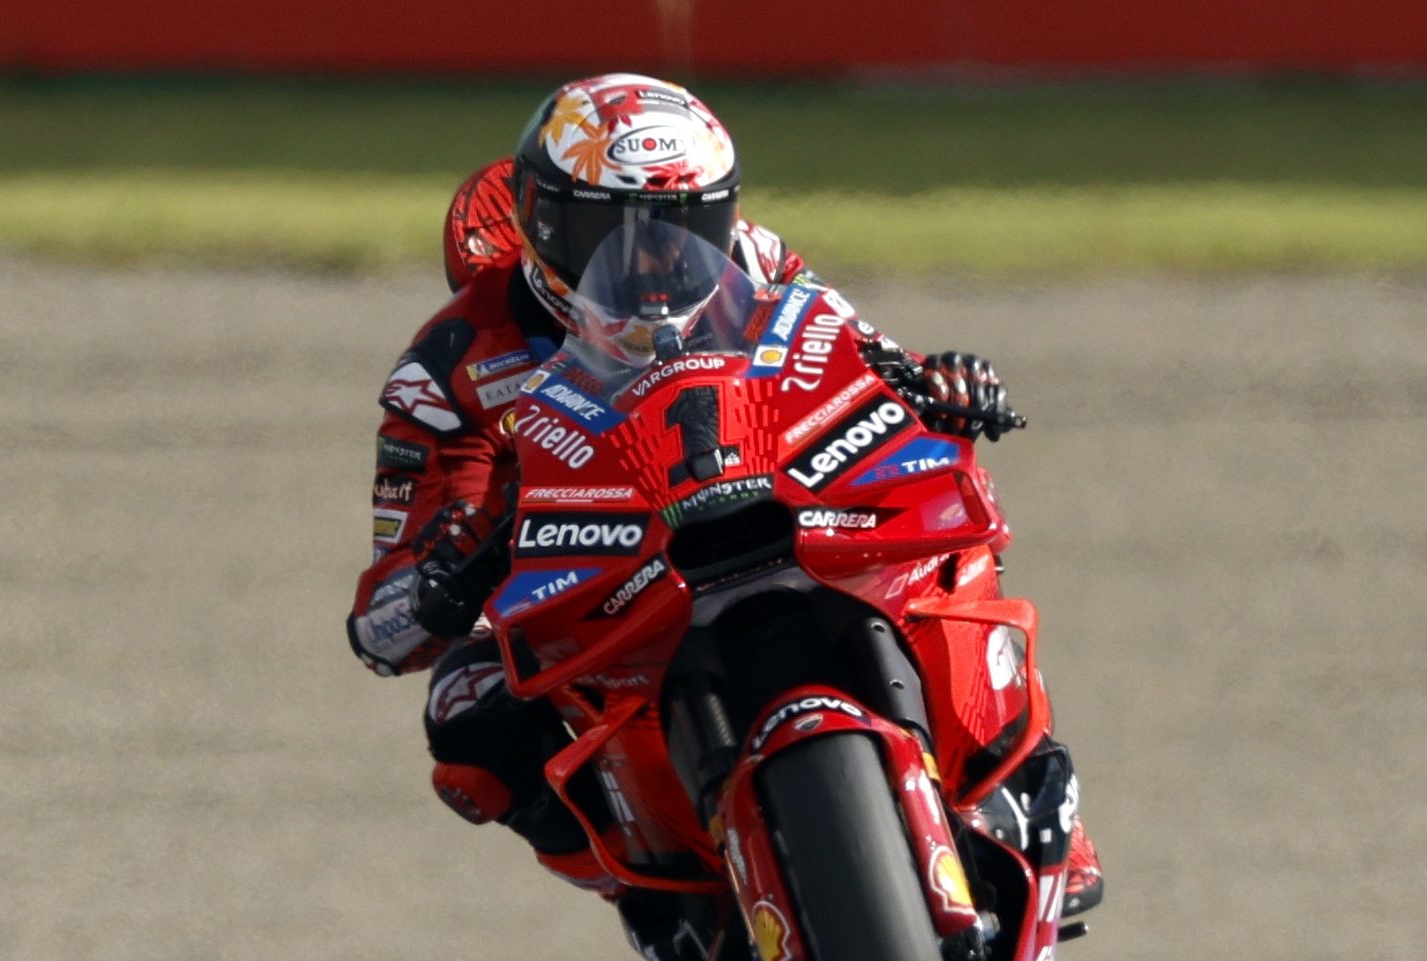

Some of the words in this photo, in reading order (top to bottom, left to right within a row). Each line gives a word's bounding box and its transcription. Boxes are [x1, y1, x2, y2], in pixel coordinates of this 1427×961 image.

[614, 137, 682, 154] SUOM
[485, 378, 527, 400] EATA
[540, 384, 605, 421] ADVANCE
[784, 373, 877, 443] FRECCIAROSSA
[666, 385, 742, 487] 1
[787, 402, 905, 488] Lenovo
[901, 457, 950, 473] TIM
[525, 488, 635, 499] FRECCIAROSSA
[518, 519, 643, 548] Lenovo
[798, 510, 877, 528] CARRERA
[908, 556, 939, 585] Audi
[531, 571, 578, 600] TIM
[603, 559, 665, 615] CARRERA
[751, 696, 862, 749] Lenovo
